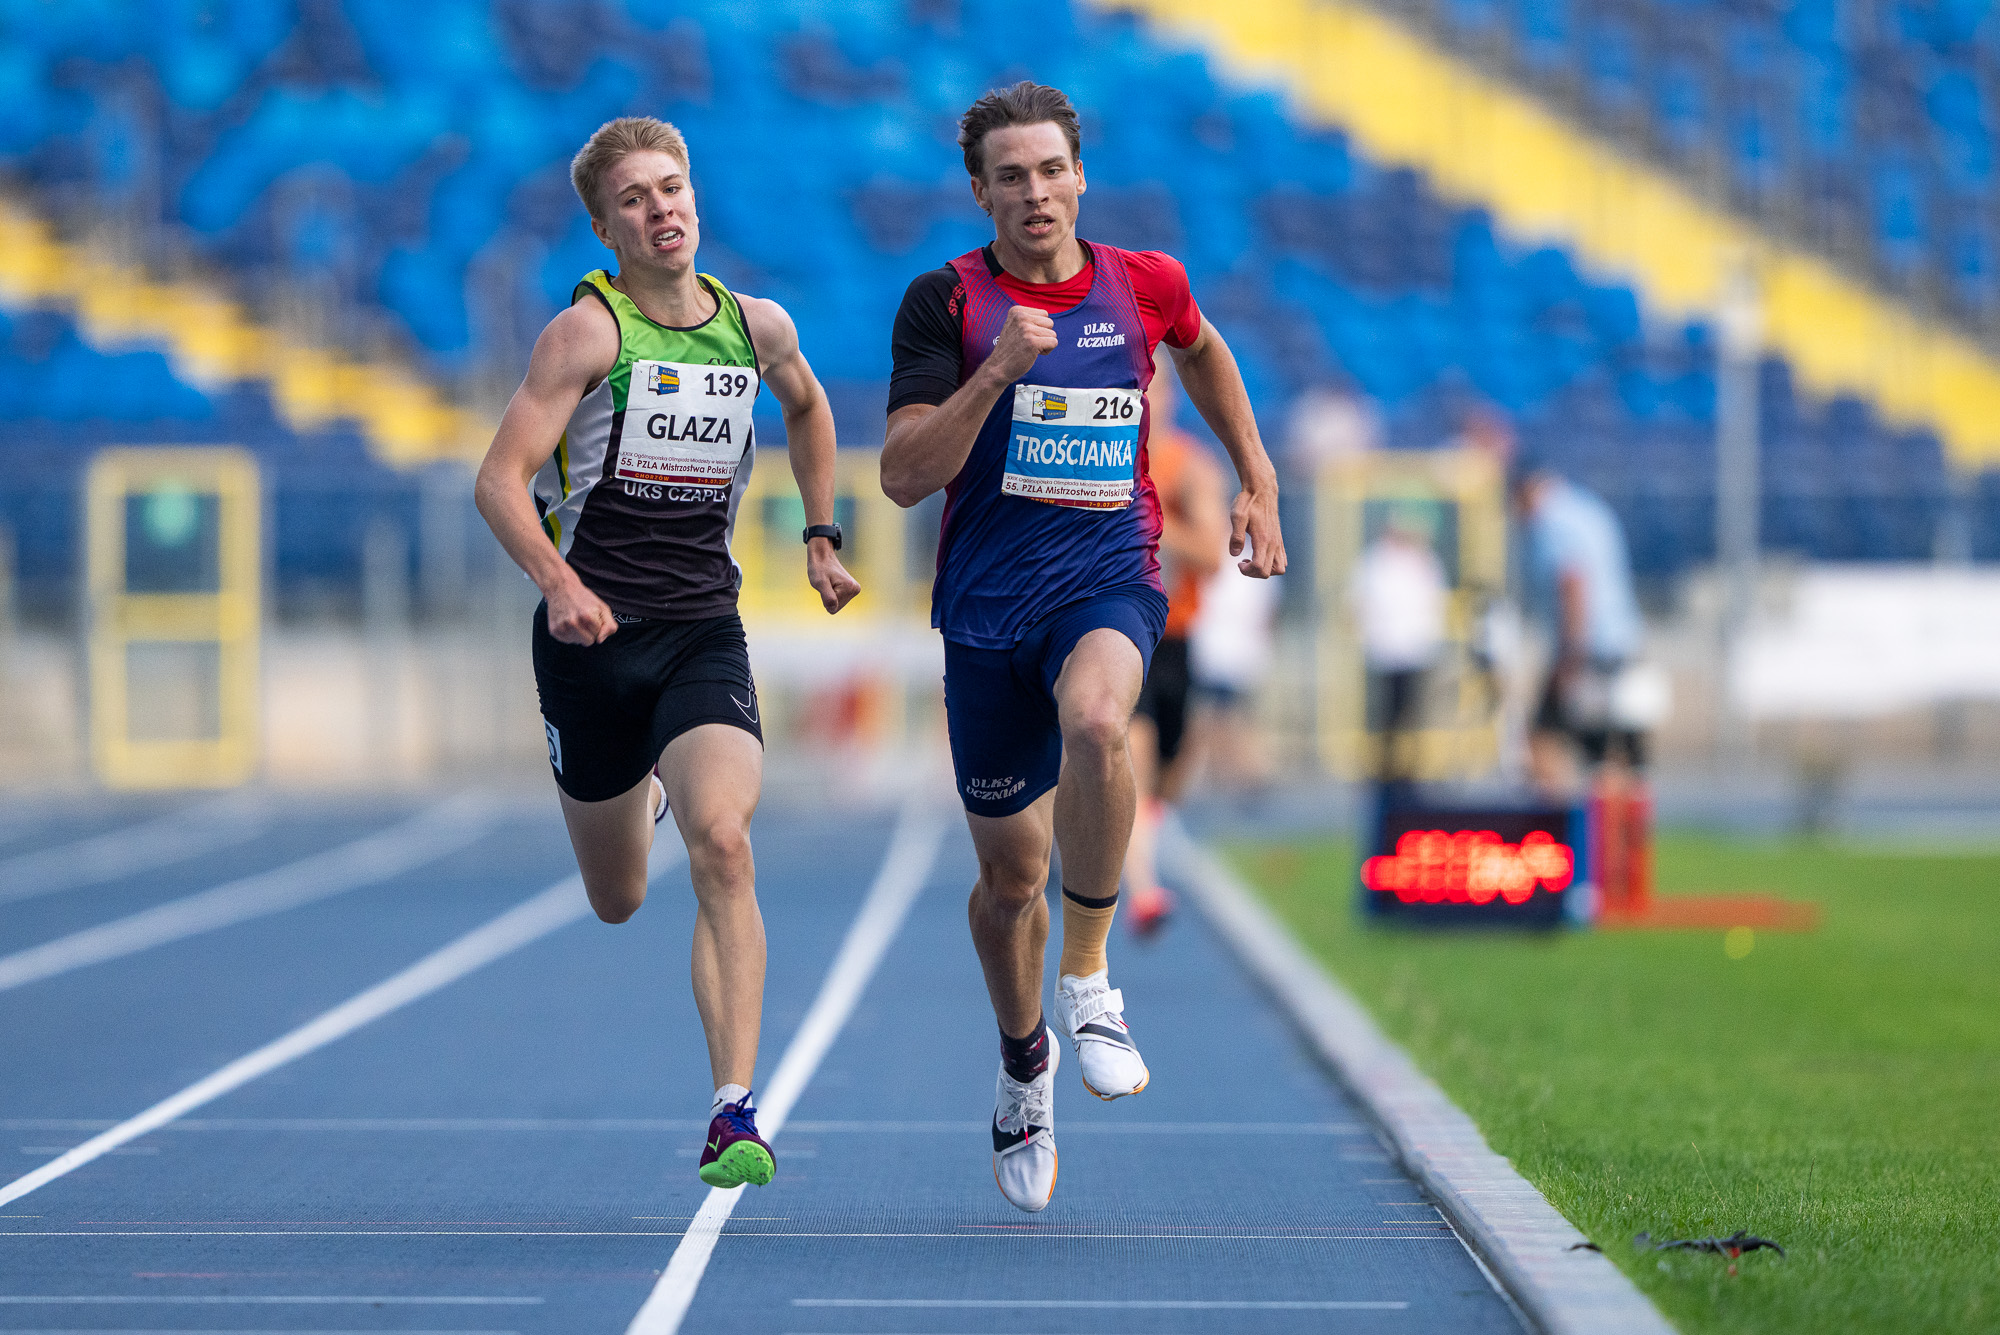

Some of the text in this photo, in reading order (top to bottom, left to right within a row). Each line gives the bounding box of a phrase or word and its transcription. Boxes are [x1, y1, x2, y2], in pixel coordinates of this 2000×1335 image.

[1083, 322, 1115, 336] ULKS
[1077, 333, 1125, 348] UCZNIAK
[704, 373, 748, 397] 139
[1093, 396, 1134, 420] 216
[647, 413, 731, 444] GLAZA
[1015, 434, 1133, 467] TROŚCIANKA
[620, 457, 634, 467] 55.
[637, 459, 657, 470] PZLA
[660, 462, 705, 473] Mistrzostwa
[707, 465, 728, 475] Polski
[634, 472, 670, 481] CHORZÓW
[624, 481, 663, 500] UKS
[1005, 481, 1019, 491] 55.
[1022, 484, 1043, 494] PZLA
[1045, 486, 1097, 497] Mistrzostwa
[1098, 489, 1119, 498] Polski
[966, 777, 1026, 801] UCZNIAK
[970, 776, 1013, 789] ULKS
[1074, 996, 1106, 1027] NIKE
